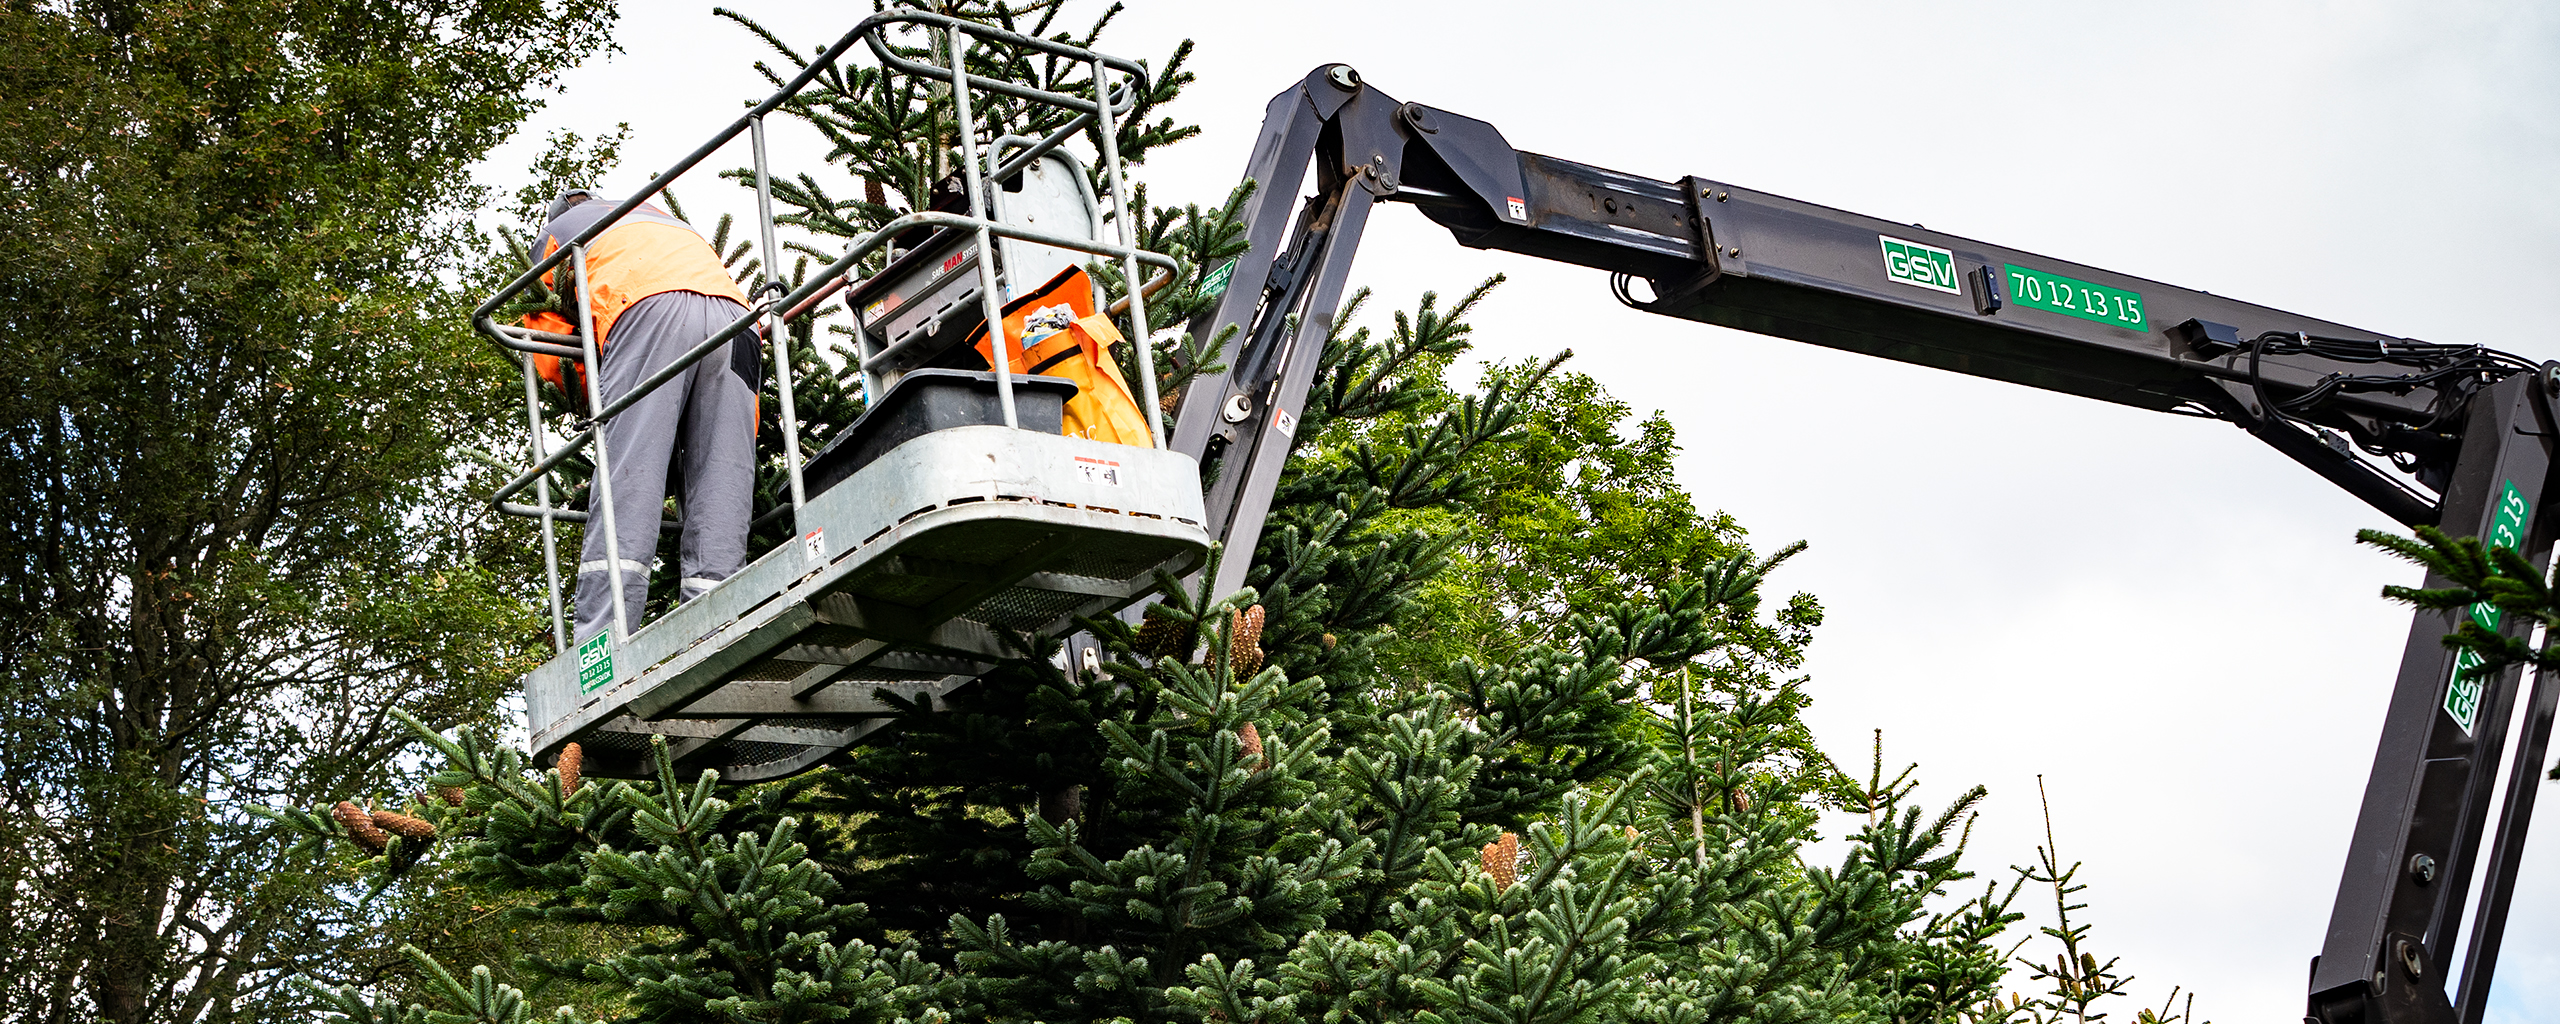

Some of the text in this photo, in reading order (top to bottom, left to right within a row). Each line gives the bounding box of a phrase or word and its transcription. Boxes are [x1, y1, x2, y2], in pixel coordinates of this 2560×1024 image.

[1888, 250, 1951, 286] GSV
[2011, 272, 2142, 324] 70 12 13 15
[2504, 490, 2524, 527] 15
[580, 641, 608, 670] GSV
[581, 659, 611, 682] 70 12 13 15
